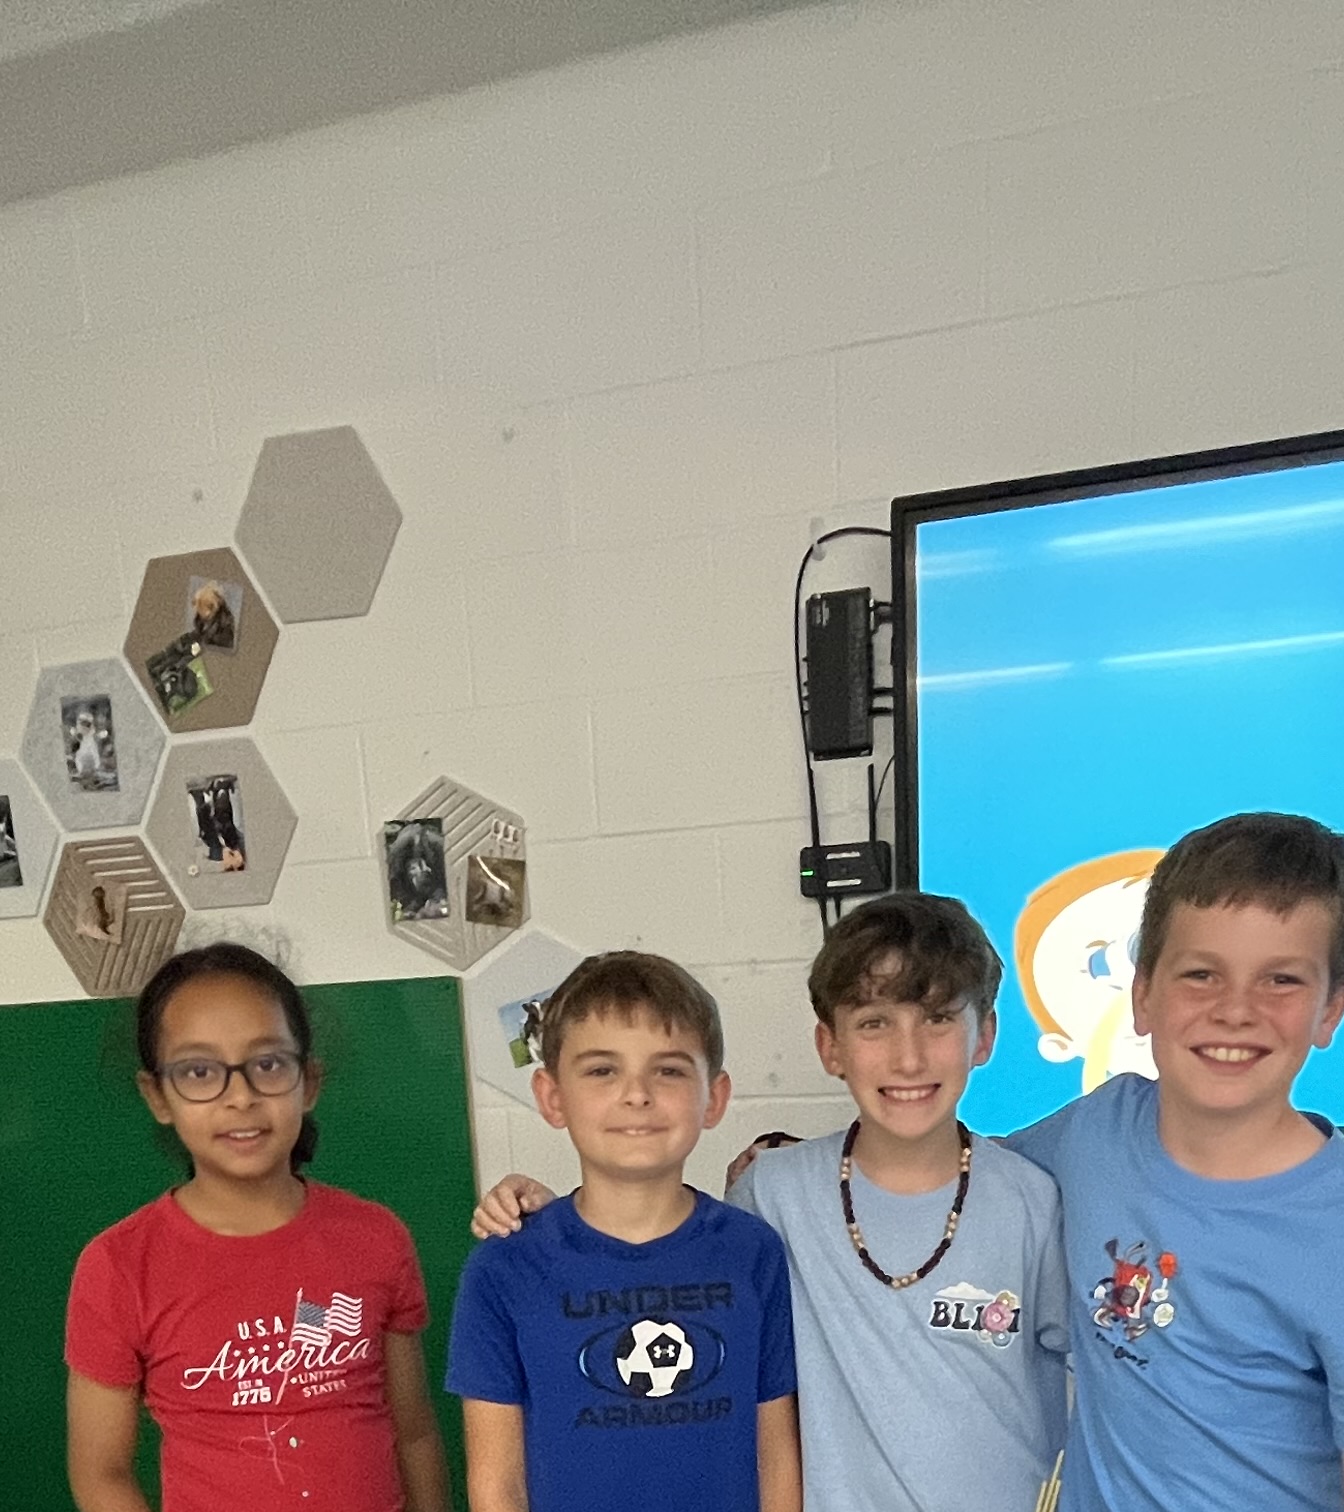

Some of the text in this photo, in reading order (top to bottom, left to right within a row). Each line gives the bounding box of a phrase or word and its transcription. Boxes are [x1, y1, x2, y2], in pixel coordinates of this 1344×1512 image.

[561, 1282, 734, 1320] UNDER
[180, 1338, 372, 1391] America
[231, 1386, 272, 1407] 1776
[575, 1396, 733, 1429] ARMOUR
